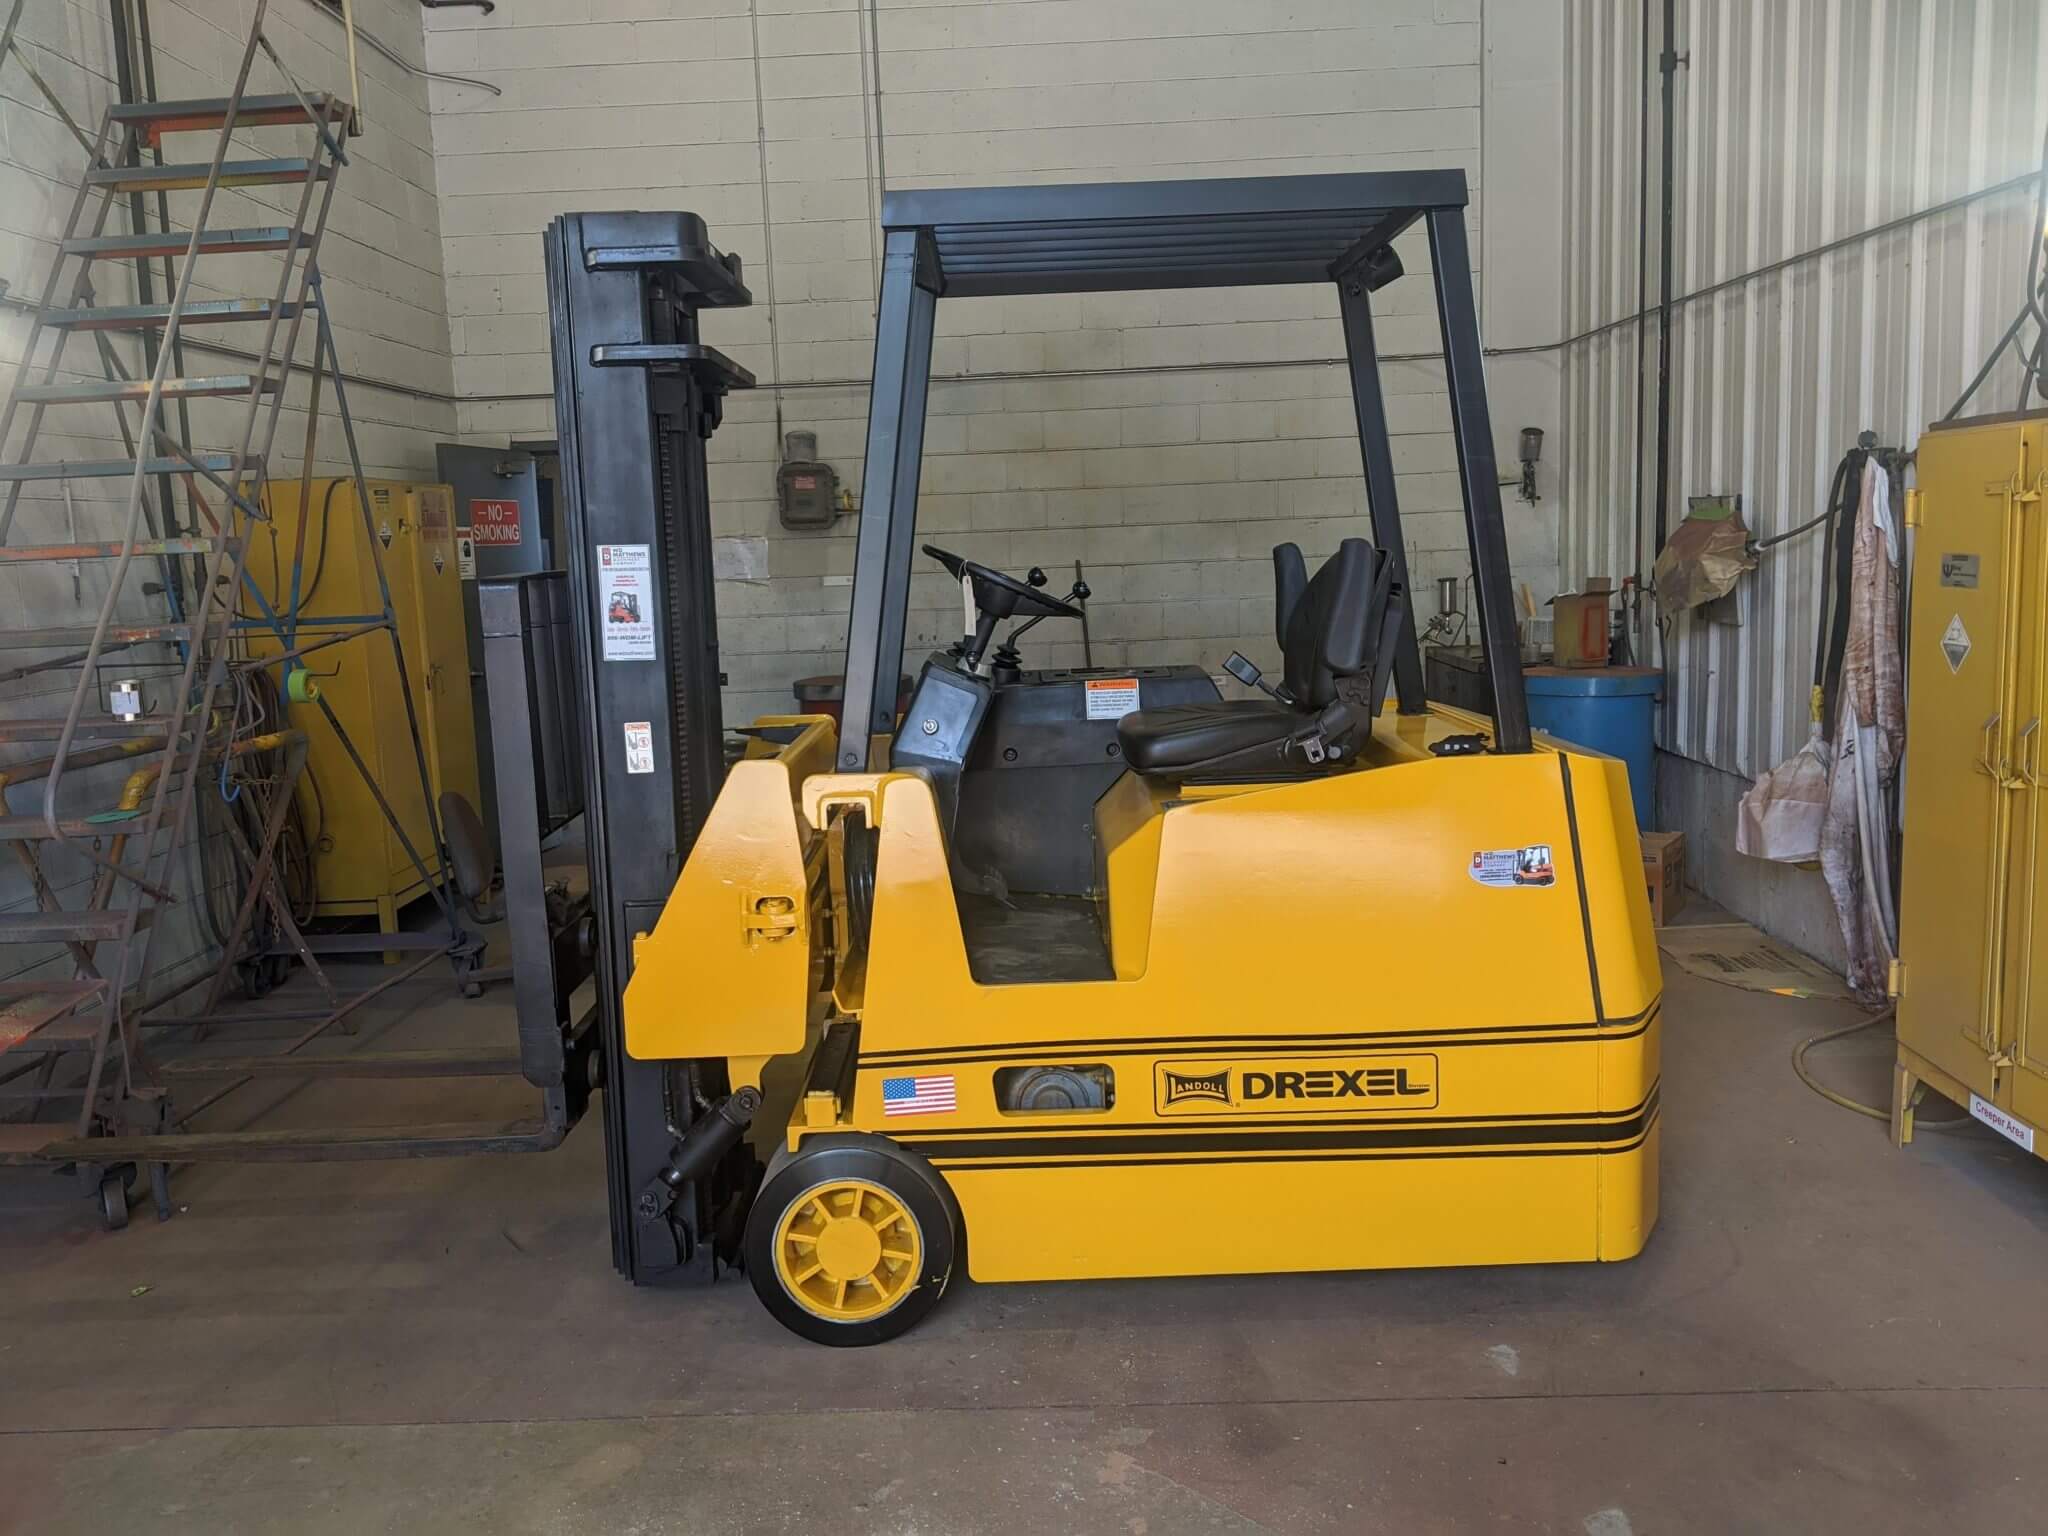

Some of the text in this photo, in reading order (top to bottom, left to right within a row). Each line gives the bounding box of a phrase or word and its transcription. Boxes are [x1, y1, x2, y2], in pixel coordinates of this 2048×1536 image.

[473, 524, 519, 541] SMOKING
[1170, 1068, 1430, 1100] LANDOLL DREXEL
[1975, 1102, 2025, 1140] Creeper Area
